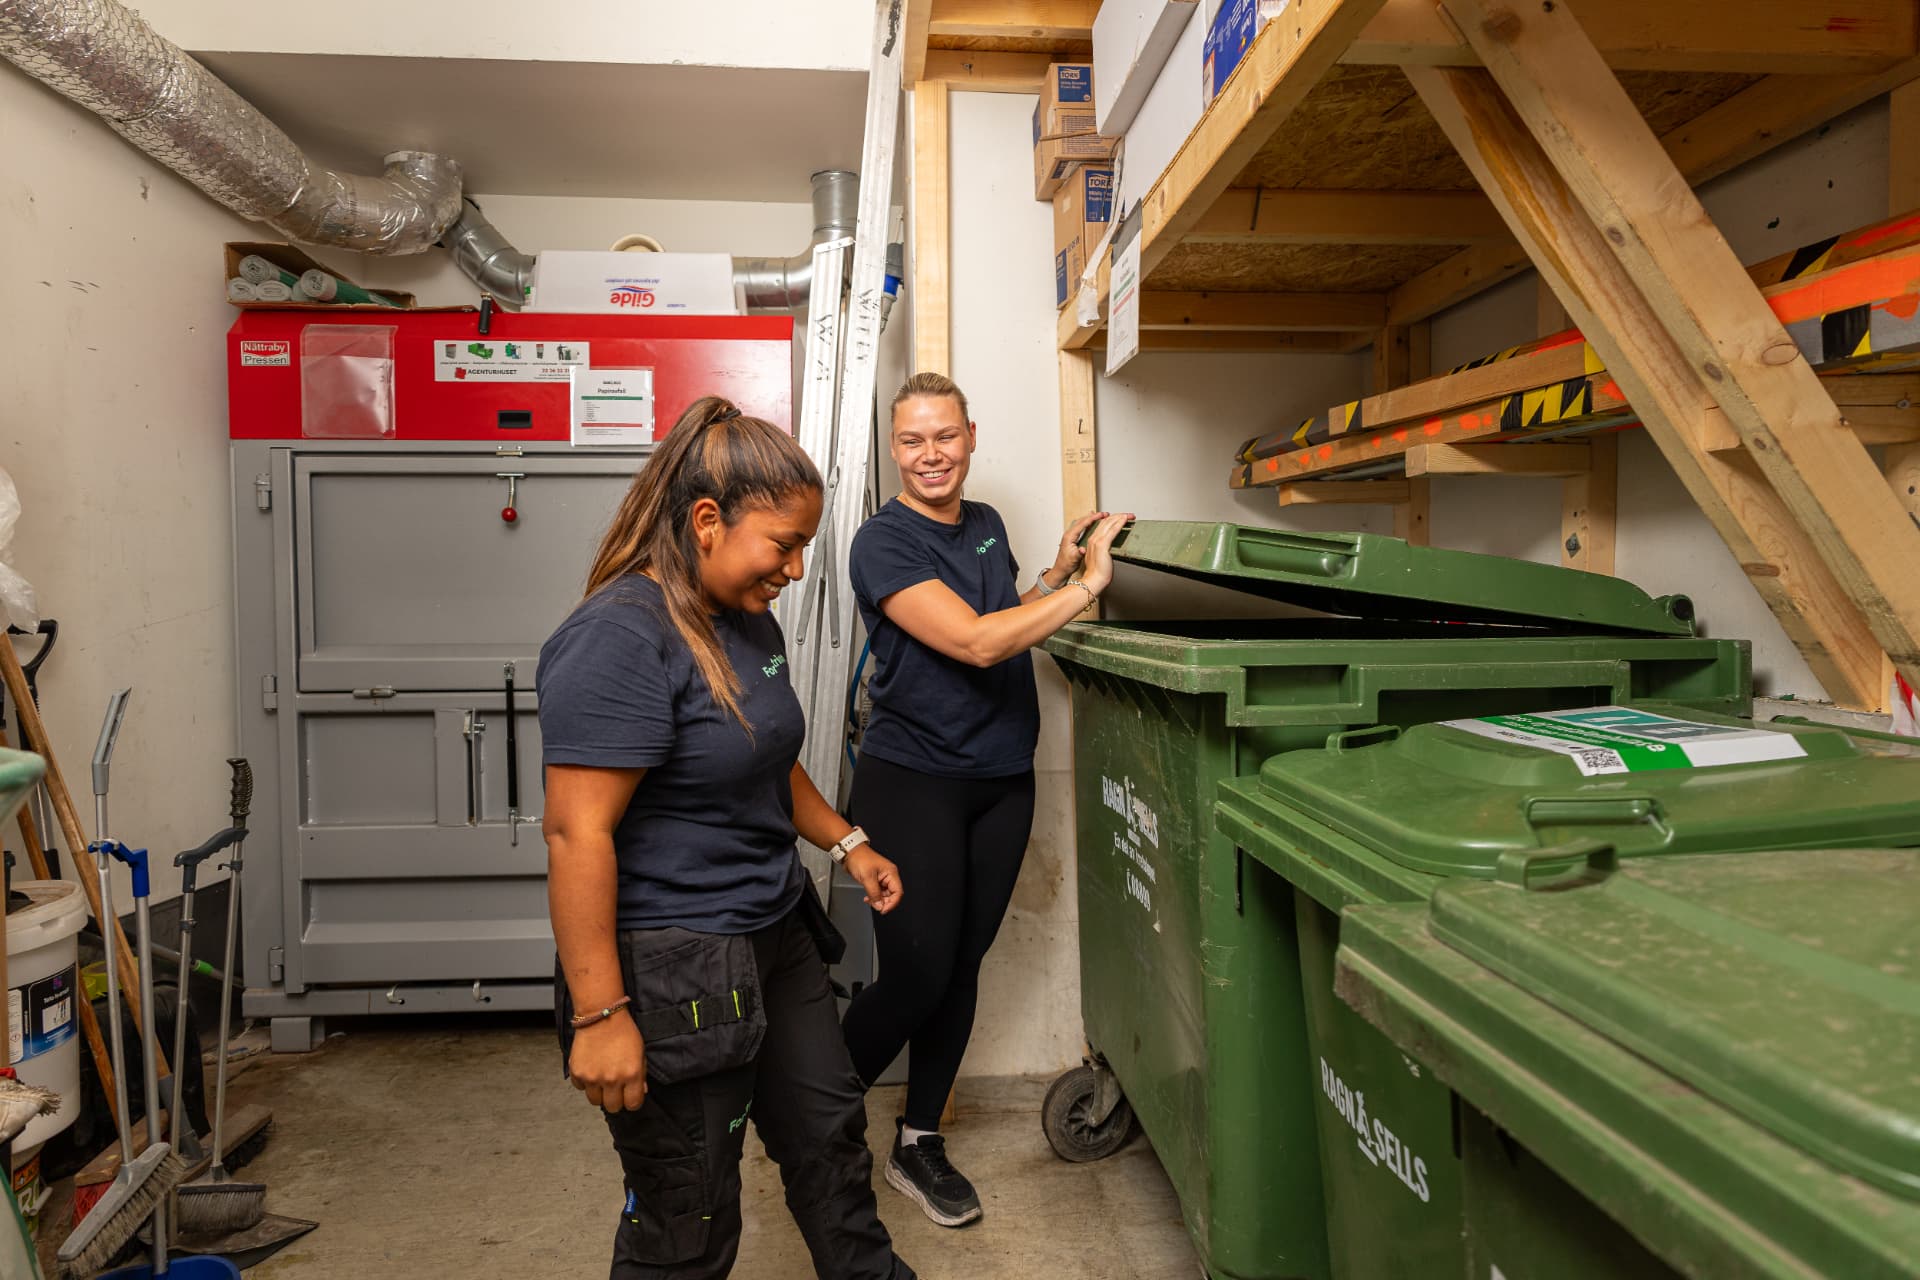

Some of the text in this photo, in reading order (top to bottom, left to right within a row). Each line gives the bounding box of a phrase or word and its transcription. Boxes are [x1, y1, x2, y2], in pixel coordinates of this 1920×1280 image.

[1061, 71, 1079, 79] TORK
[610, 292, 655, 307] Gilde
[244, 342, 286, 353] Nättraby
[244, 355, 287, 364] Pressen
[1102, 775, 1127, 819] RAGN
[1320, 1055, 1430, 1203] RAGN SELLS
